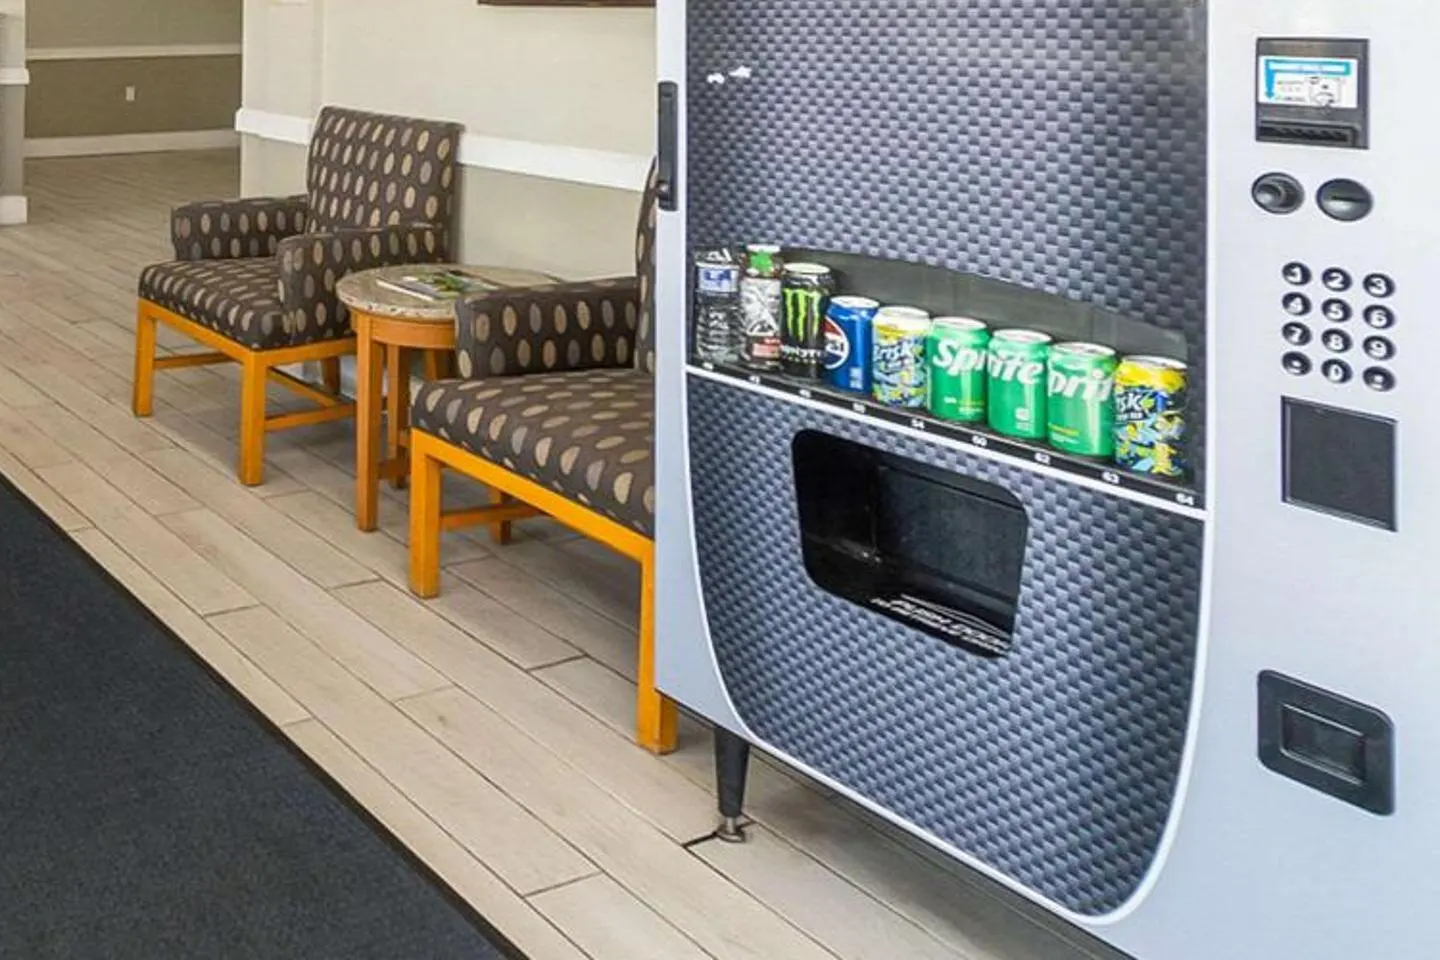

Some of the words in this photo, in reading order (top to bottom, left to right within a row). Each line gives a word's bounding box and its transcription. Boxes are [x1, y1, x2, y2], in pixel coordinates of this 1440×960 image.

[1326, 271, 1345, 286] 2
[1368, 277, 1387, 296] 3
[1286, 297, 1303, 315] 4
[1327, 303, 1343, 321] 5
[1370, 310, 1387, 327] 6
[1289, 326, 1302, 343] 7
[1329, 334, 1344, 351] 8
[1369, 341, 1387, 358] 9
[1329, 363, 1343, 381] 0
